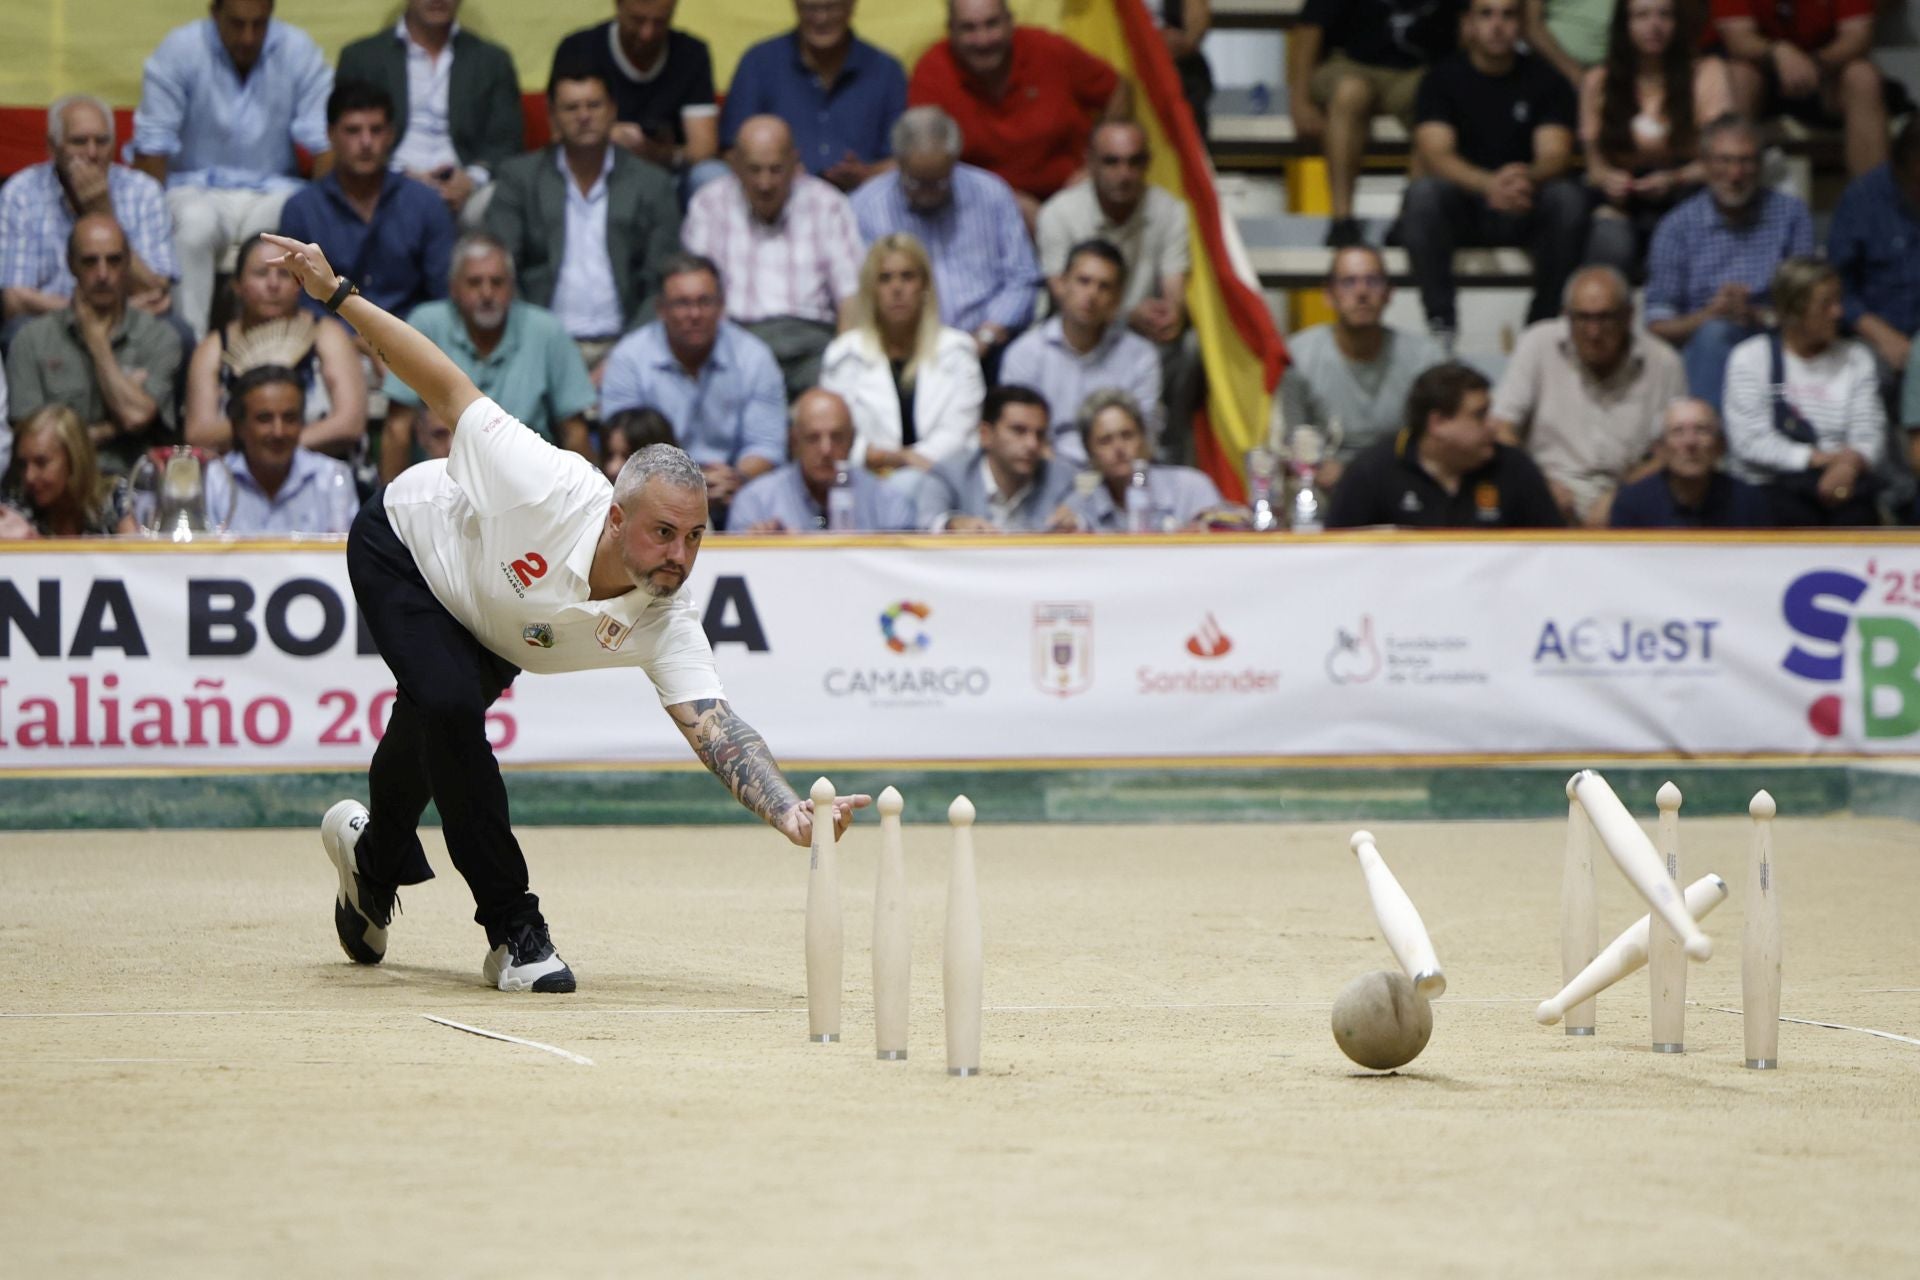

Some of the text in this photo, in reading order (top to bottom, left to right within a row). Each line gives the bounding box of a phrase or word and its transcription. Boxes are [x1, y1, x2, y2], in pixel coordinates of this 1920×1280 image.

[500, 560, 526, 599] CAMARGO
[511, 552, 548, 588] 2
[823, 666, 991, 697] CAMARGO
[1136, 665, 1283, 696] Santander
[0, 674, 293, 748] aliaño
